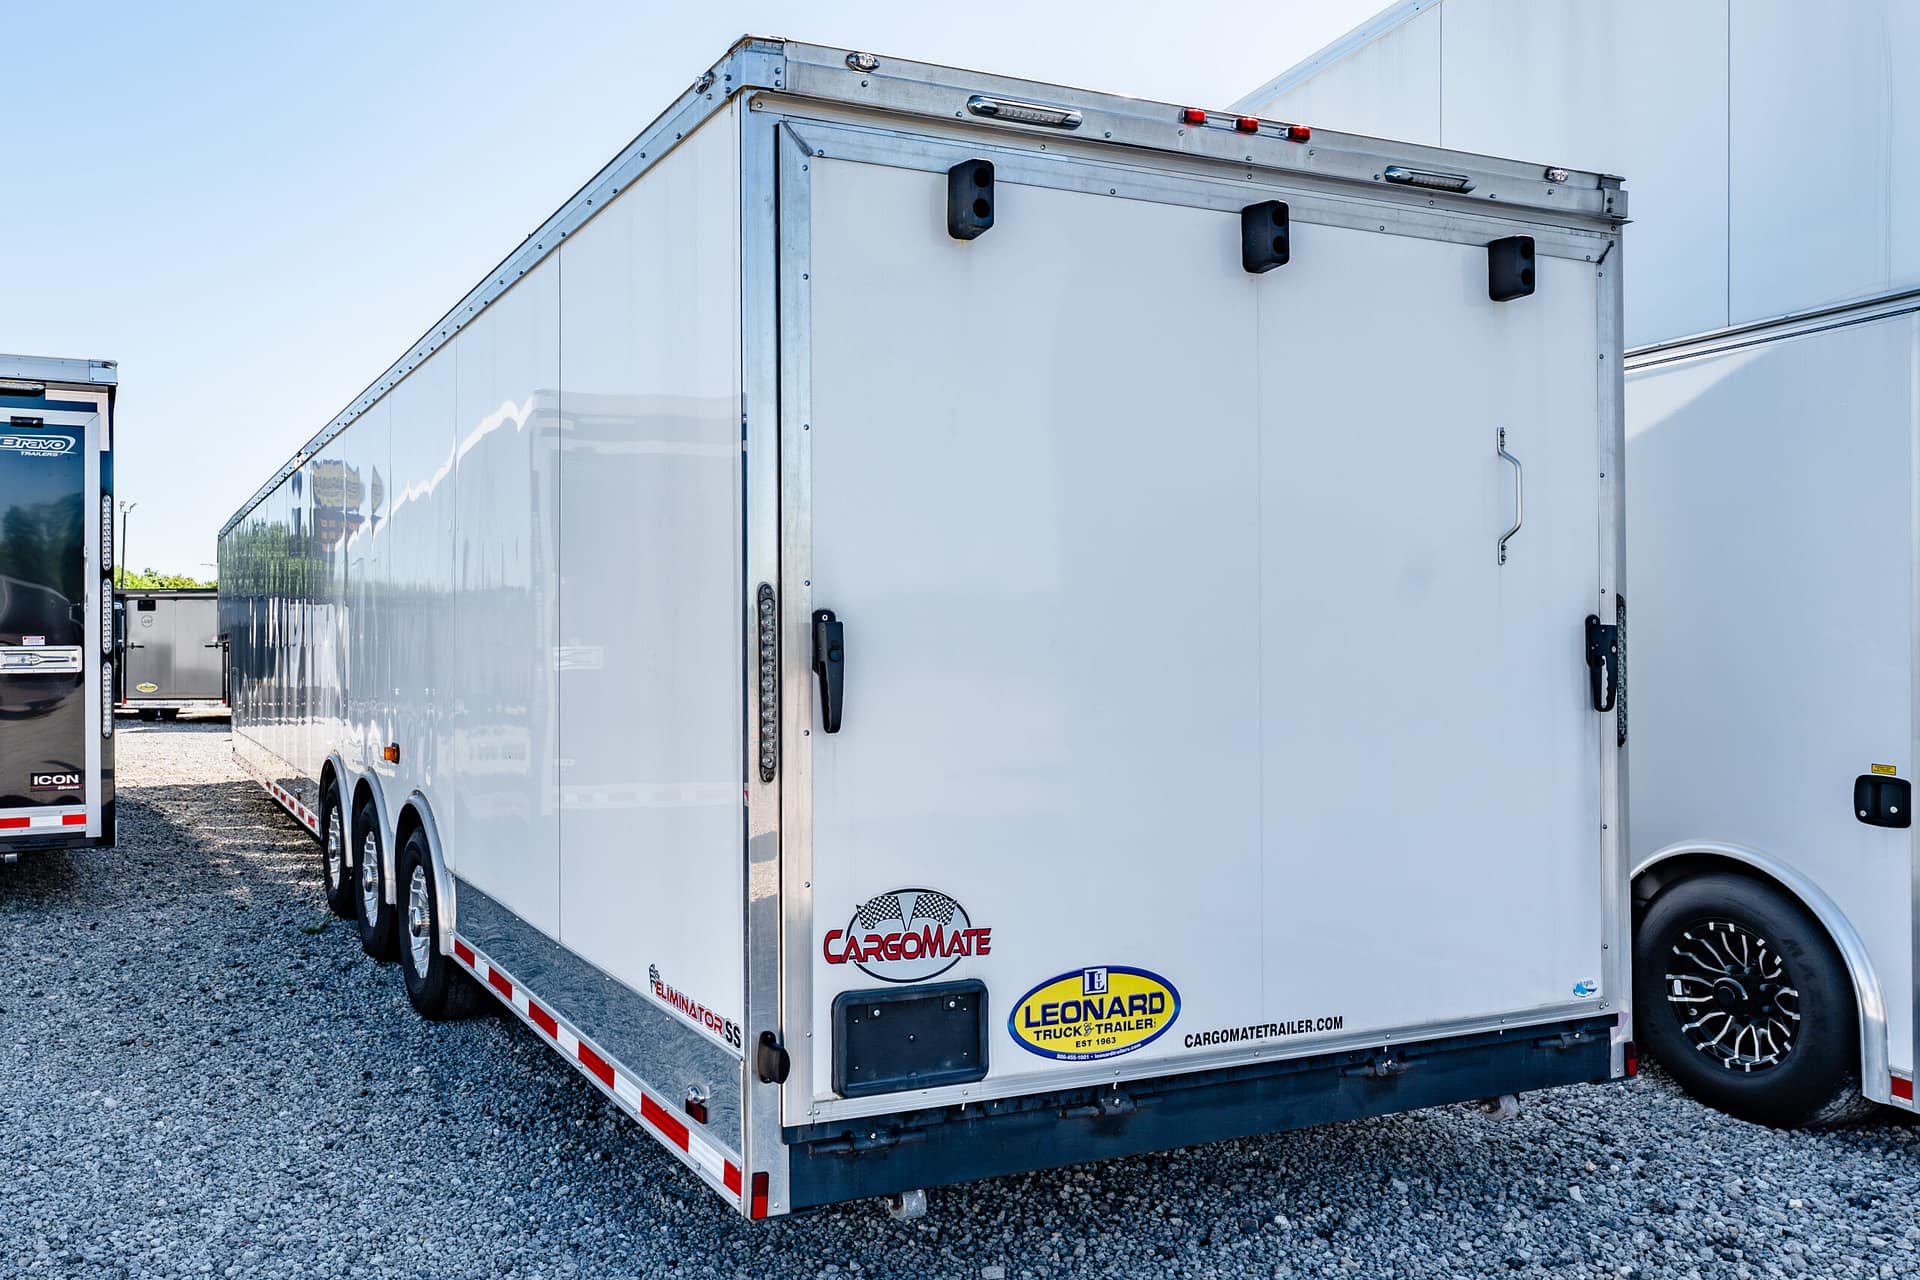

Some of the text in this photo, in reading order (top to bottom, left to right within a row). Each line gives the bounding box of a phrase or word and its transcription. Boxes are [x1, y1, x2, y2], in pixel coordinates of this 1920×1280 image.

[0, 437, 65, 449] Bravo
[33, 774, 79, 785] ICON
[655, 979, 741, 1049] ELIMINATOR SS
[1024, 991, 1165, 1028] LEONARD
[1034, 1025, 1082, 1041] TRUCK
[1095, 1018, 1153, 1034] TRAILER
[1184, 1016, 1343, 1048] CARGOMATETRAILER.COM
[1076, 1036, 1116, 1048] EST 1963
